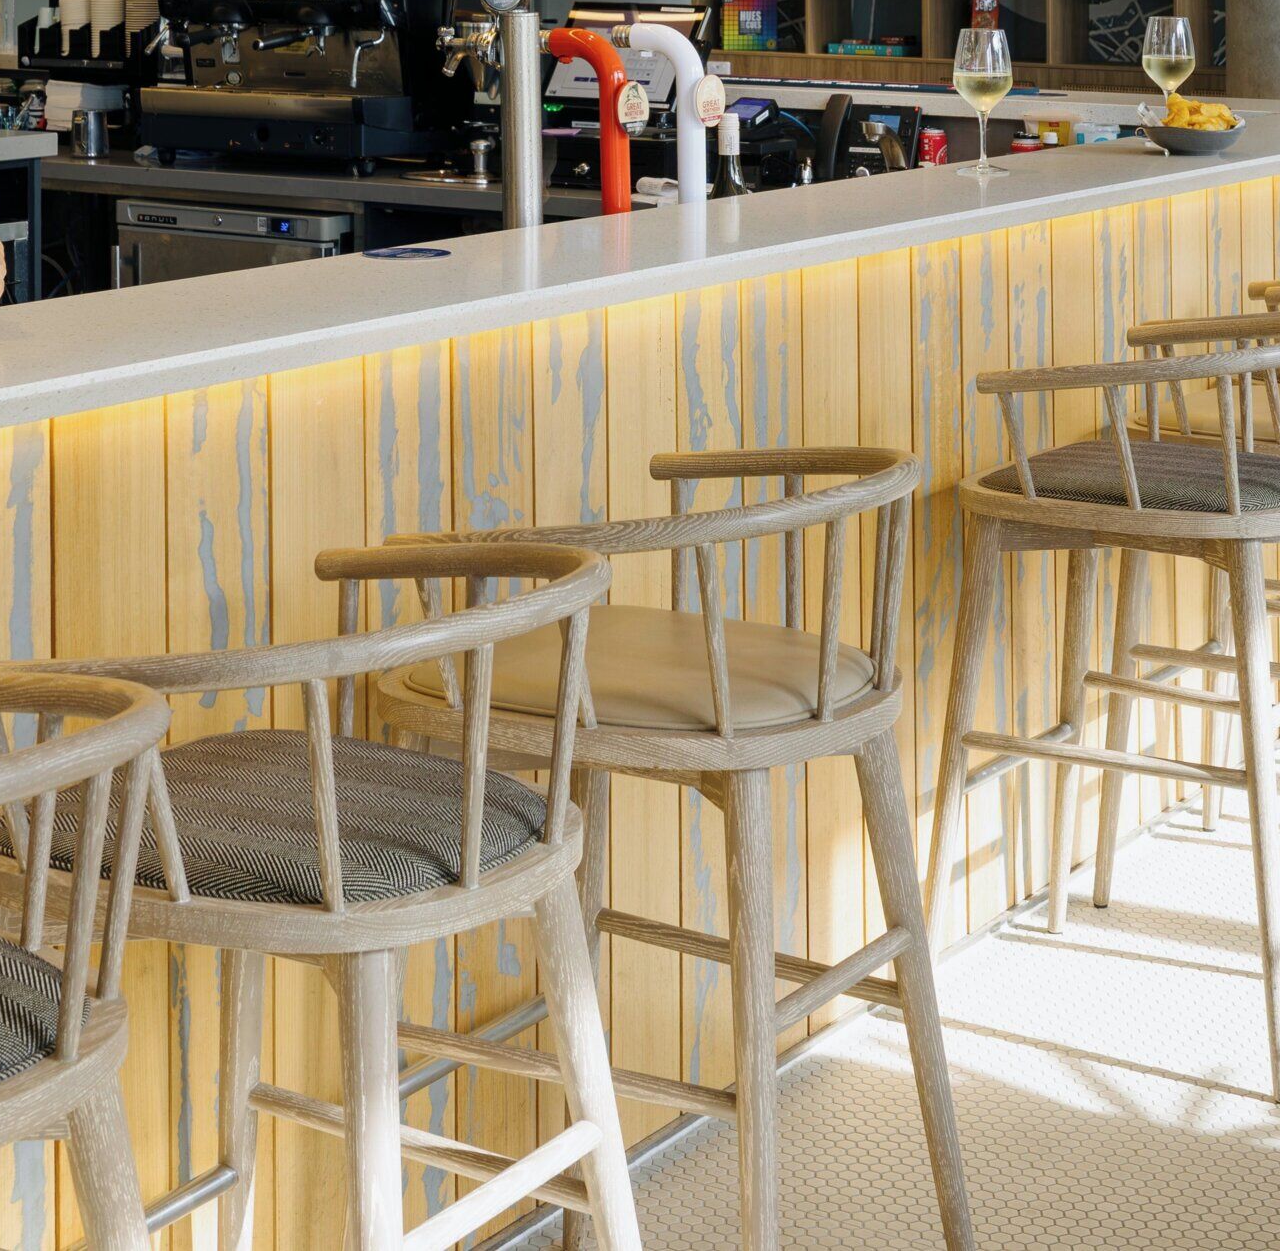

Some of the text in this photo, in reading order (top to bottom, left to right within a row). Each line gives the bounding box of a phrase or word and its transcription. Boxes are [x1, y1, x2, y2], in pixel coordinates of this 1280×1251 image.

[739, 10, 762, 22] HUES
[626, 102, 642, 110] GREAT
[702, 99, 720, 107] GREAT
